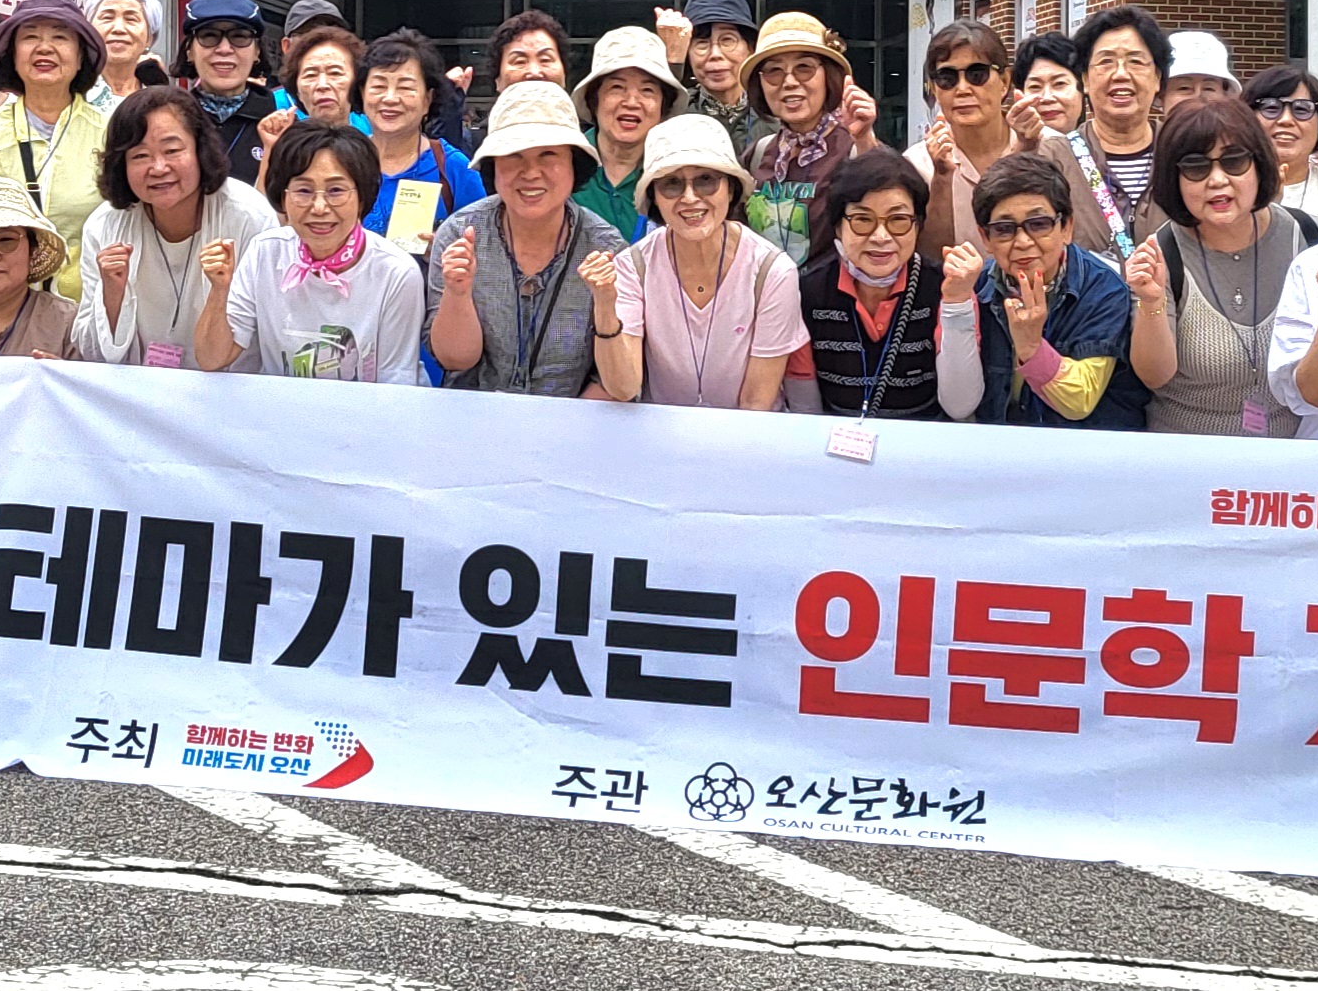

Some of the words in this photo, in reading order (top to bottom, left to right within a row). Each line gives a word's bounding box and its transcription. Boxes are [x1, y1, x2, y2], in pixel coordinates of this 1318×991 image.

[456, 544, 738, 708] 있는
[795, 571, 1256, 744] 인문학
[66, 716, 159, 768] 주최
[182, 748, 266, 773] 미래도시
[269, 754, 312, 777] 오산
[186, 724, 268, 750] 함께하는
[273, 732, 315, 755] 변화
[551, 764, 649, 813] 주관
[766, 775, 987, 825] 오산문화원
[763, 818, 814, 830] OSAN
[820, 823, 913, 838] CULTURAL
[917, 830, 986, 844] CENTER
